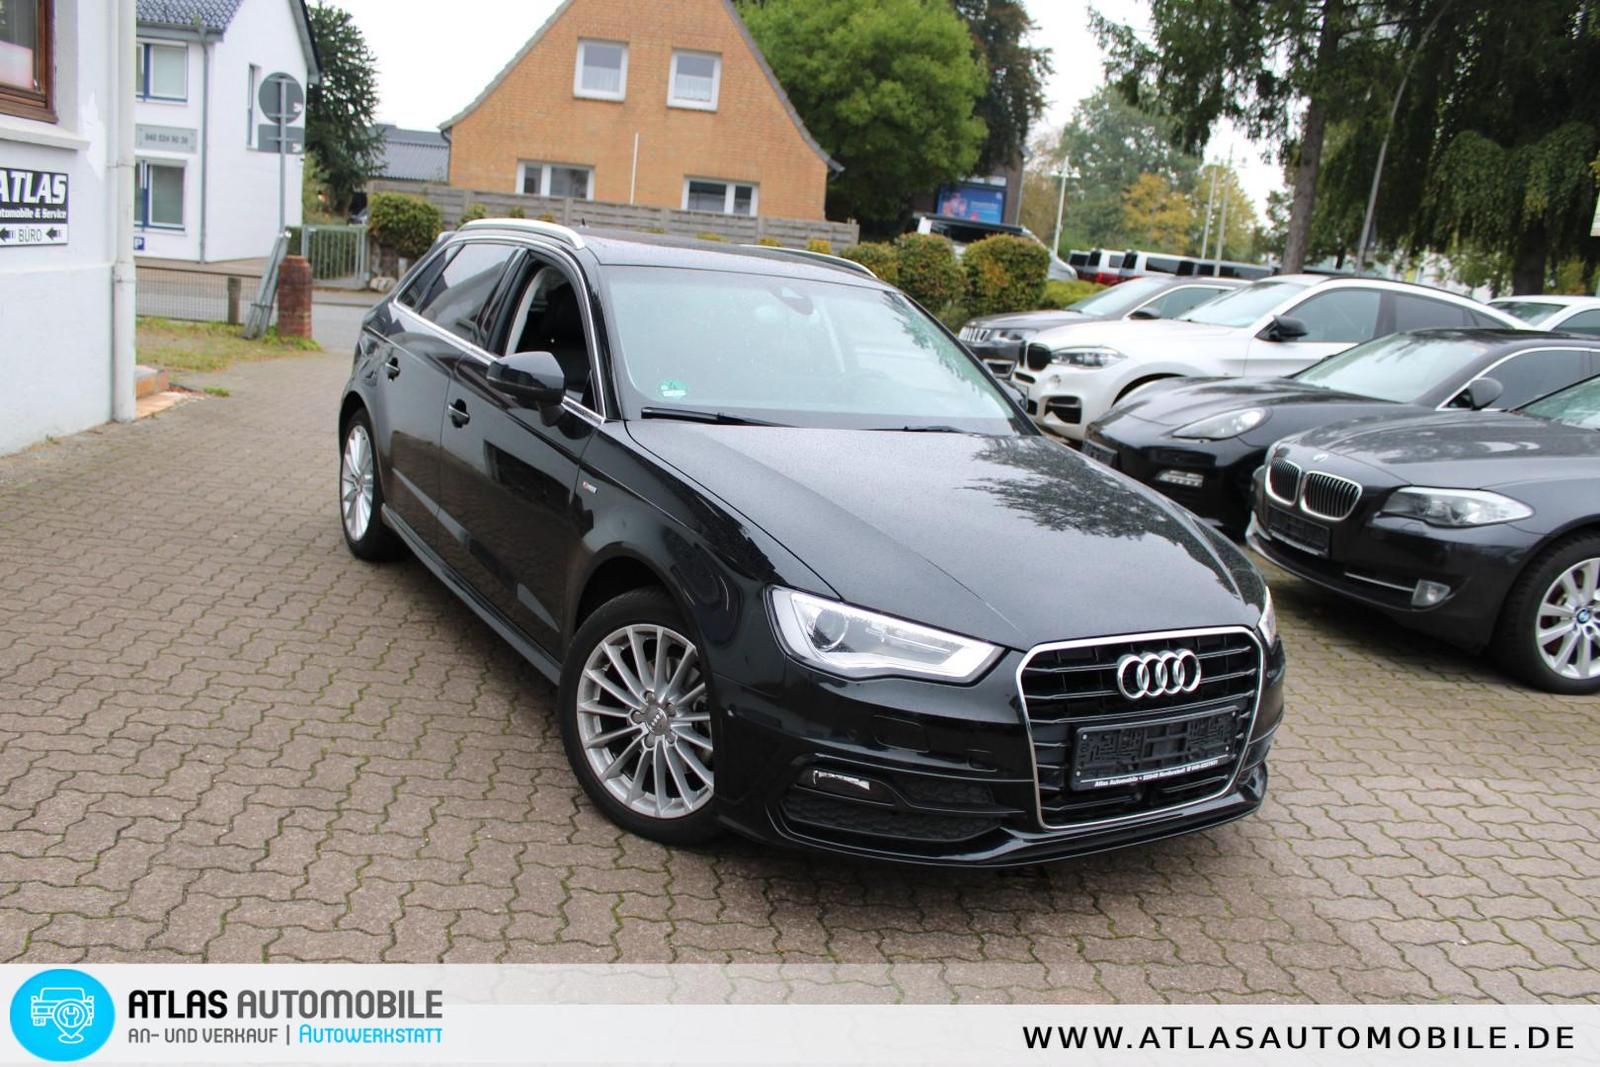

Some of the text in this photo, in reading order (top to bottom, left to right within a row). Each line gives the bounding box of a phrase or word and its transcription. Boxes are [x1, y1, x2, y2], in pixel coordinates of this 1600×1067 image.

[0, 169, 67, 204] ATLAS
[42, 208, 67, 219] Service
[18, 226, 42, 242] BÜRO
